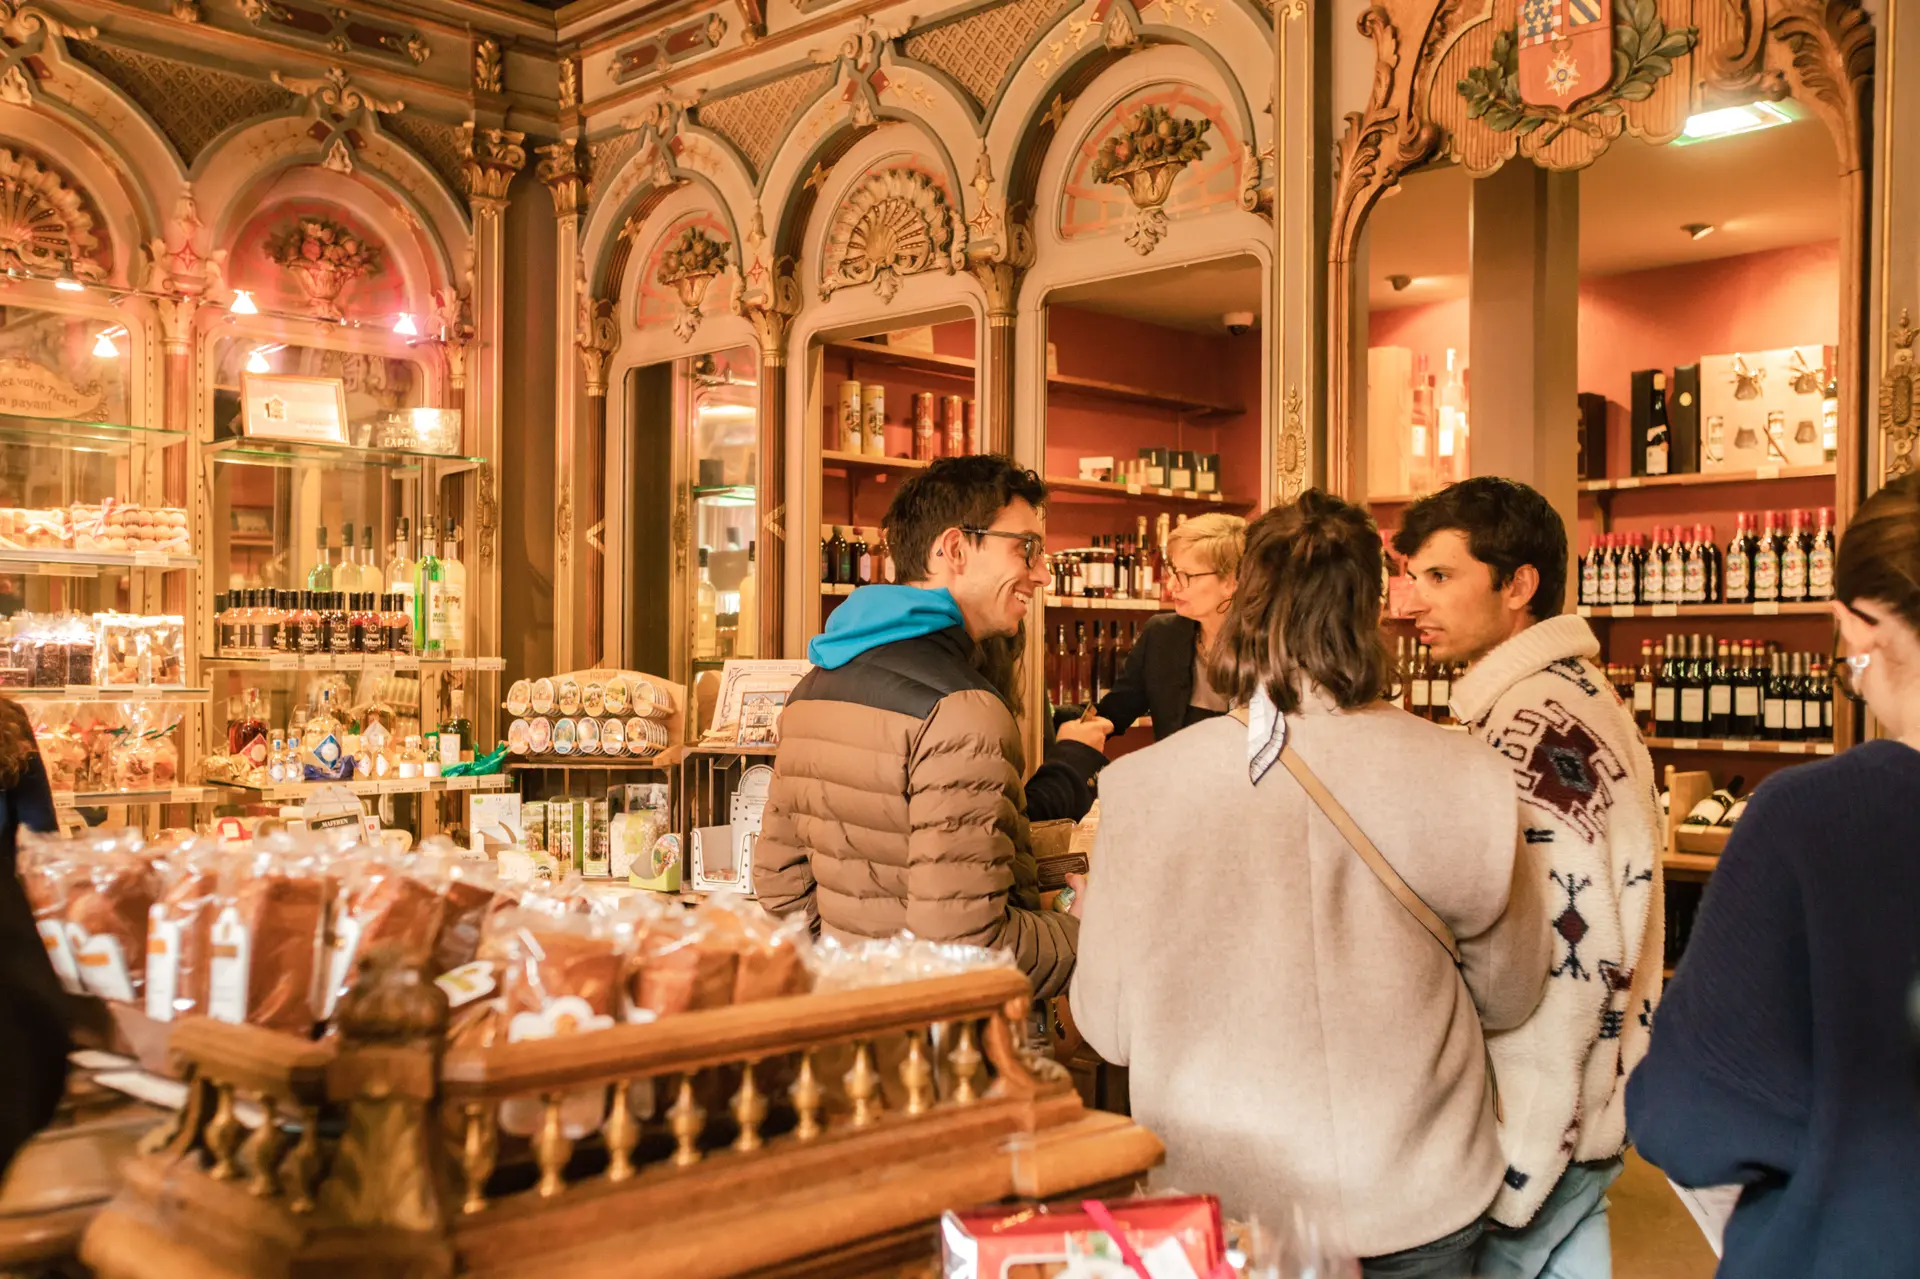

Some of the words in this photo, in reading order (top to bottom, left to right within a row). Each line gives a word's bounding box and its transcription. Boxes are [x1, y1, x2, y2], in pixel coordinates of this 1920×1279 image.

[17, 378, 45, 391] votre
[48, 385, 78, 408] Ticket
[388, 414, 401, 423] LA
